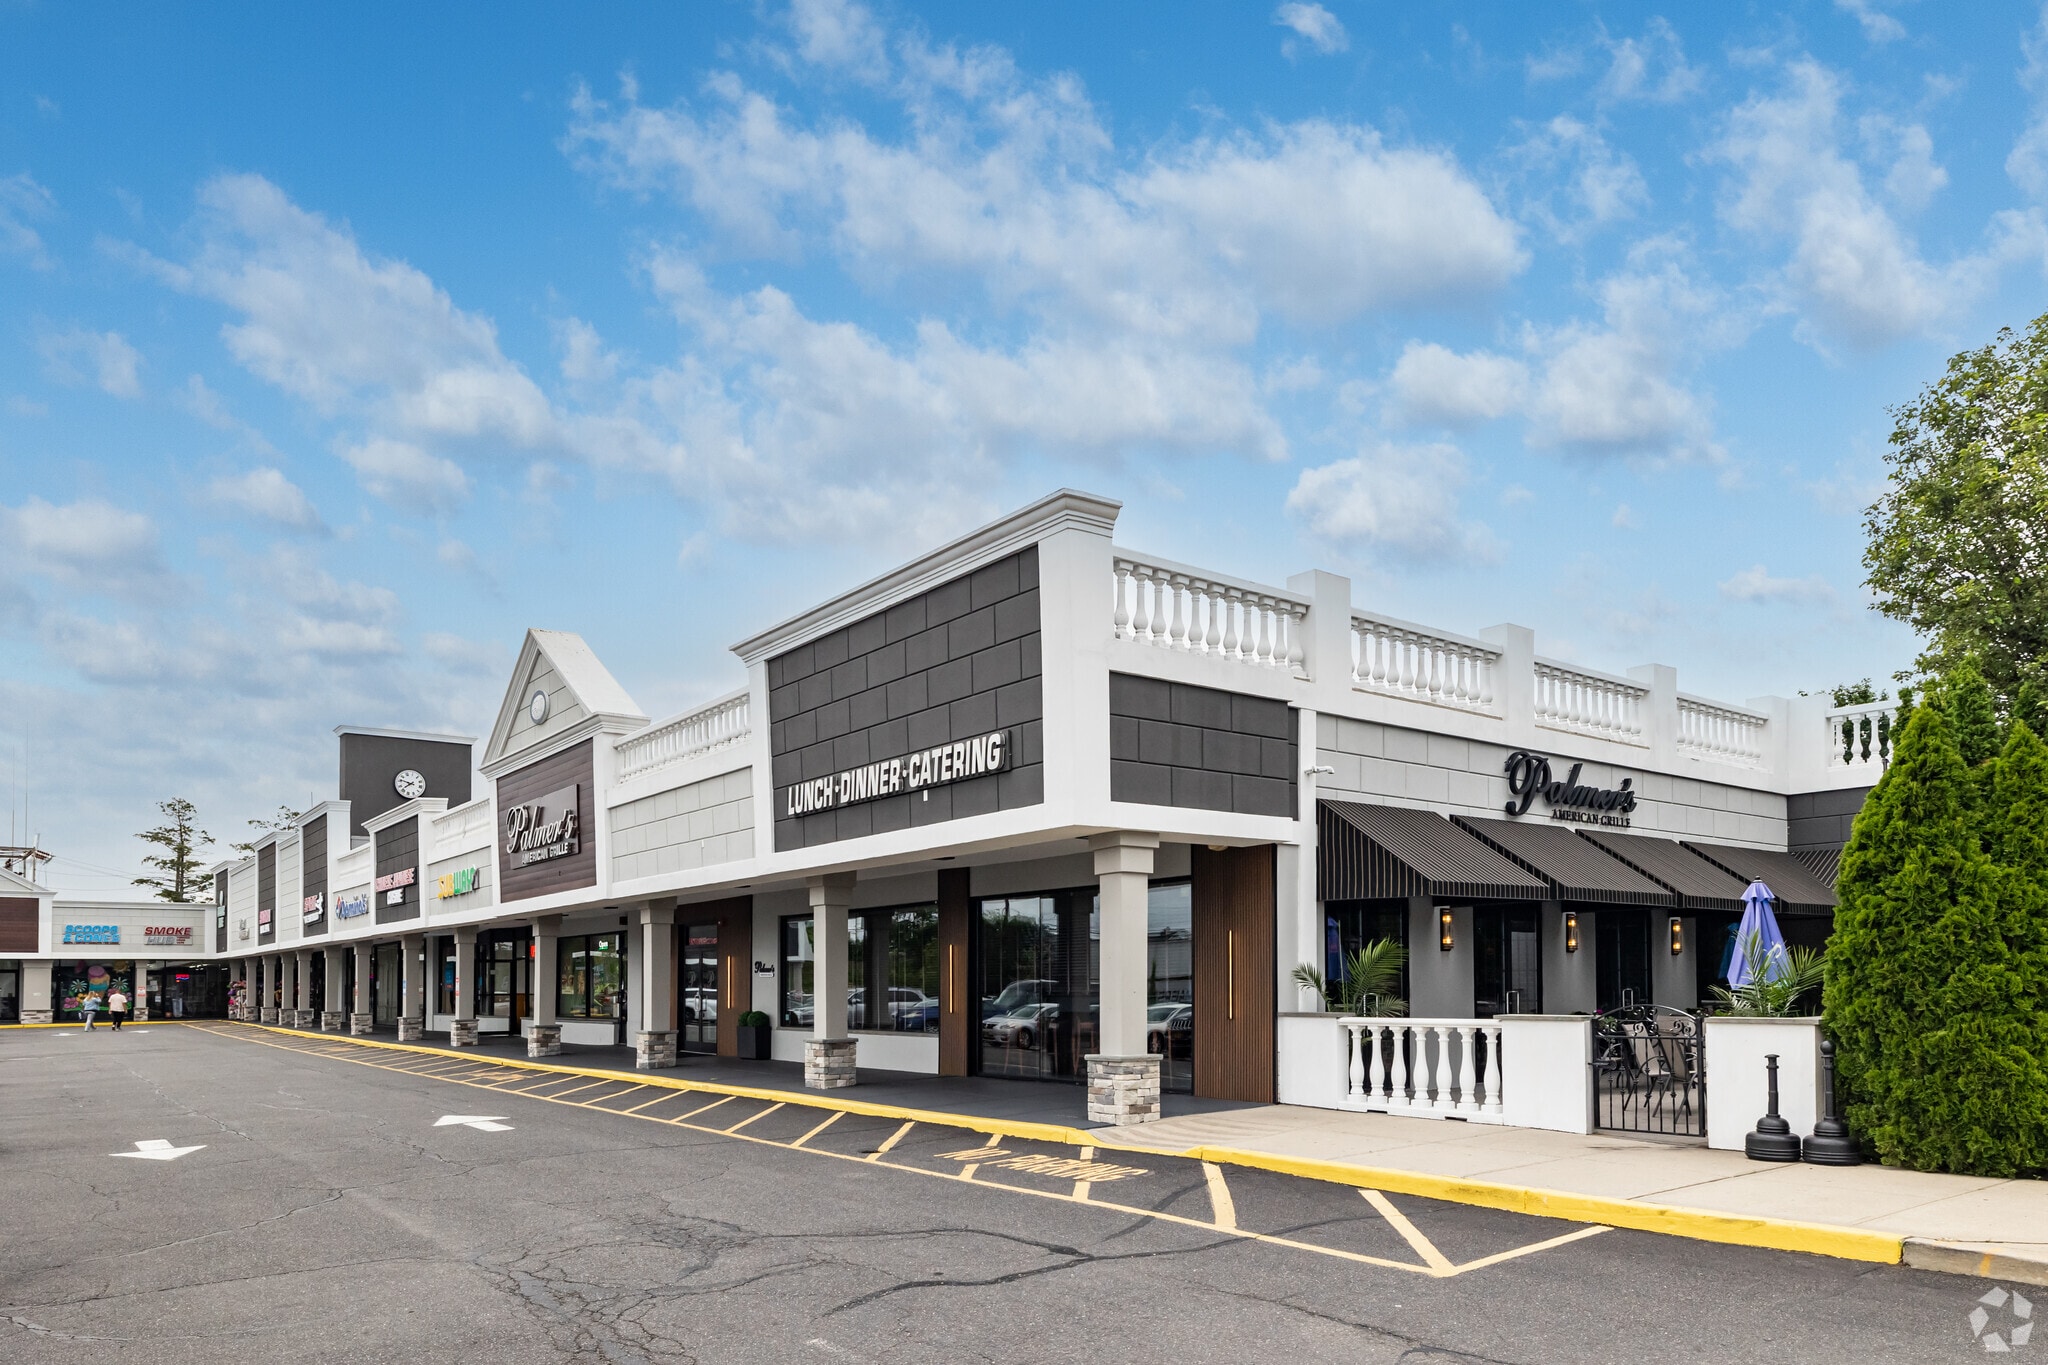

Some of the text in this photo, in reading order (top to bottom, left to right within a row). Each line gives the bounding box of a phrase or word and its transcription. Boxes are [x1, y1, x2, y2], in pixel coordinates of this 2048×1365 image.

[787, 733, 1005, 816] LUNCH DINNER CATERING
[1504, 751, 1638, 816] Palmer's
[506, 806, 577, 854] Palmer's
[1552, 809, 1631, 828] AMERICAN GRILLE
[522, 843, 569, 865] AMERICAN GRILLE
[437, 864, 478, 900] SUBWAY
[65, 925, 119, 934] SCOOPS
[75, 934, 121, 942] CONES
[145, 927, 192, 935] SMOKE
[933, 1147, 1149, 1181] NO PARKING
